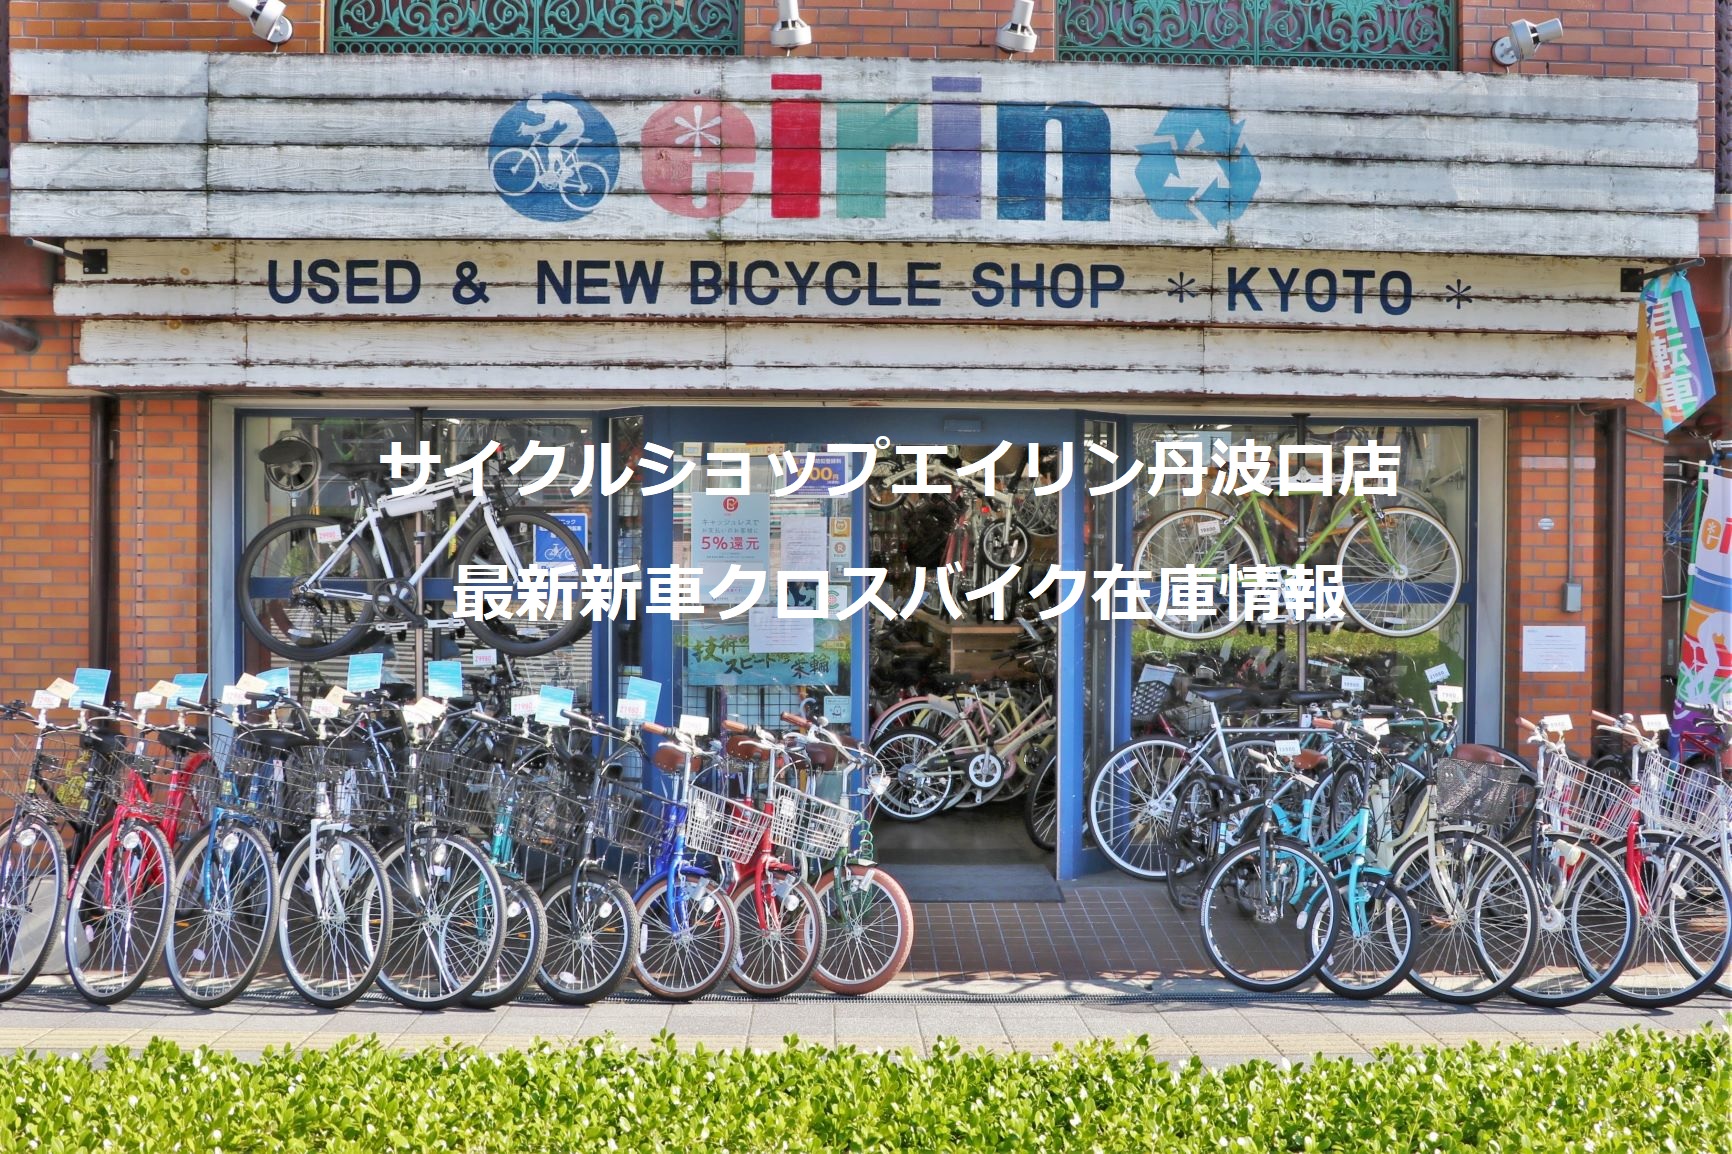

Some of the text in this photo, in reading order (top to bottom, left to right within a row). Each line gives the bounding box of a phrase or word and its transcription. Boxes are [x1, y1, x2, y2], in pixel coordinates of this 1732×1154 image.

[641, 74, 1111, 221] eirin
[268, 259, 1412, 315] USED & NEW BICYCLE SHOP KYOTO
[701, 536, 760, 550] 5%還元
